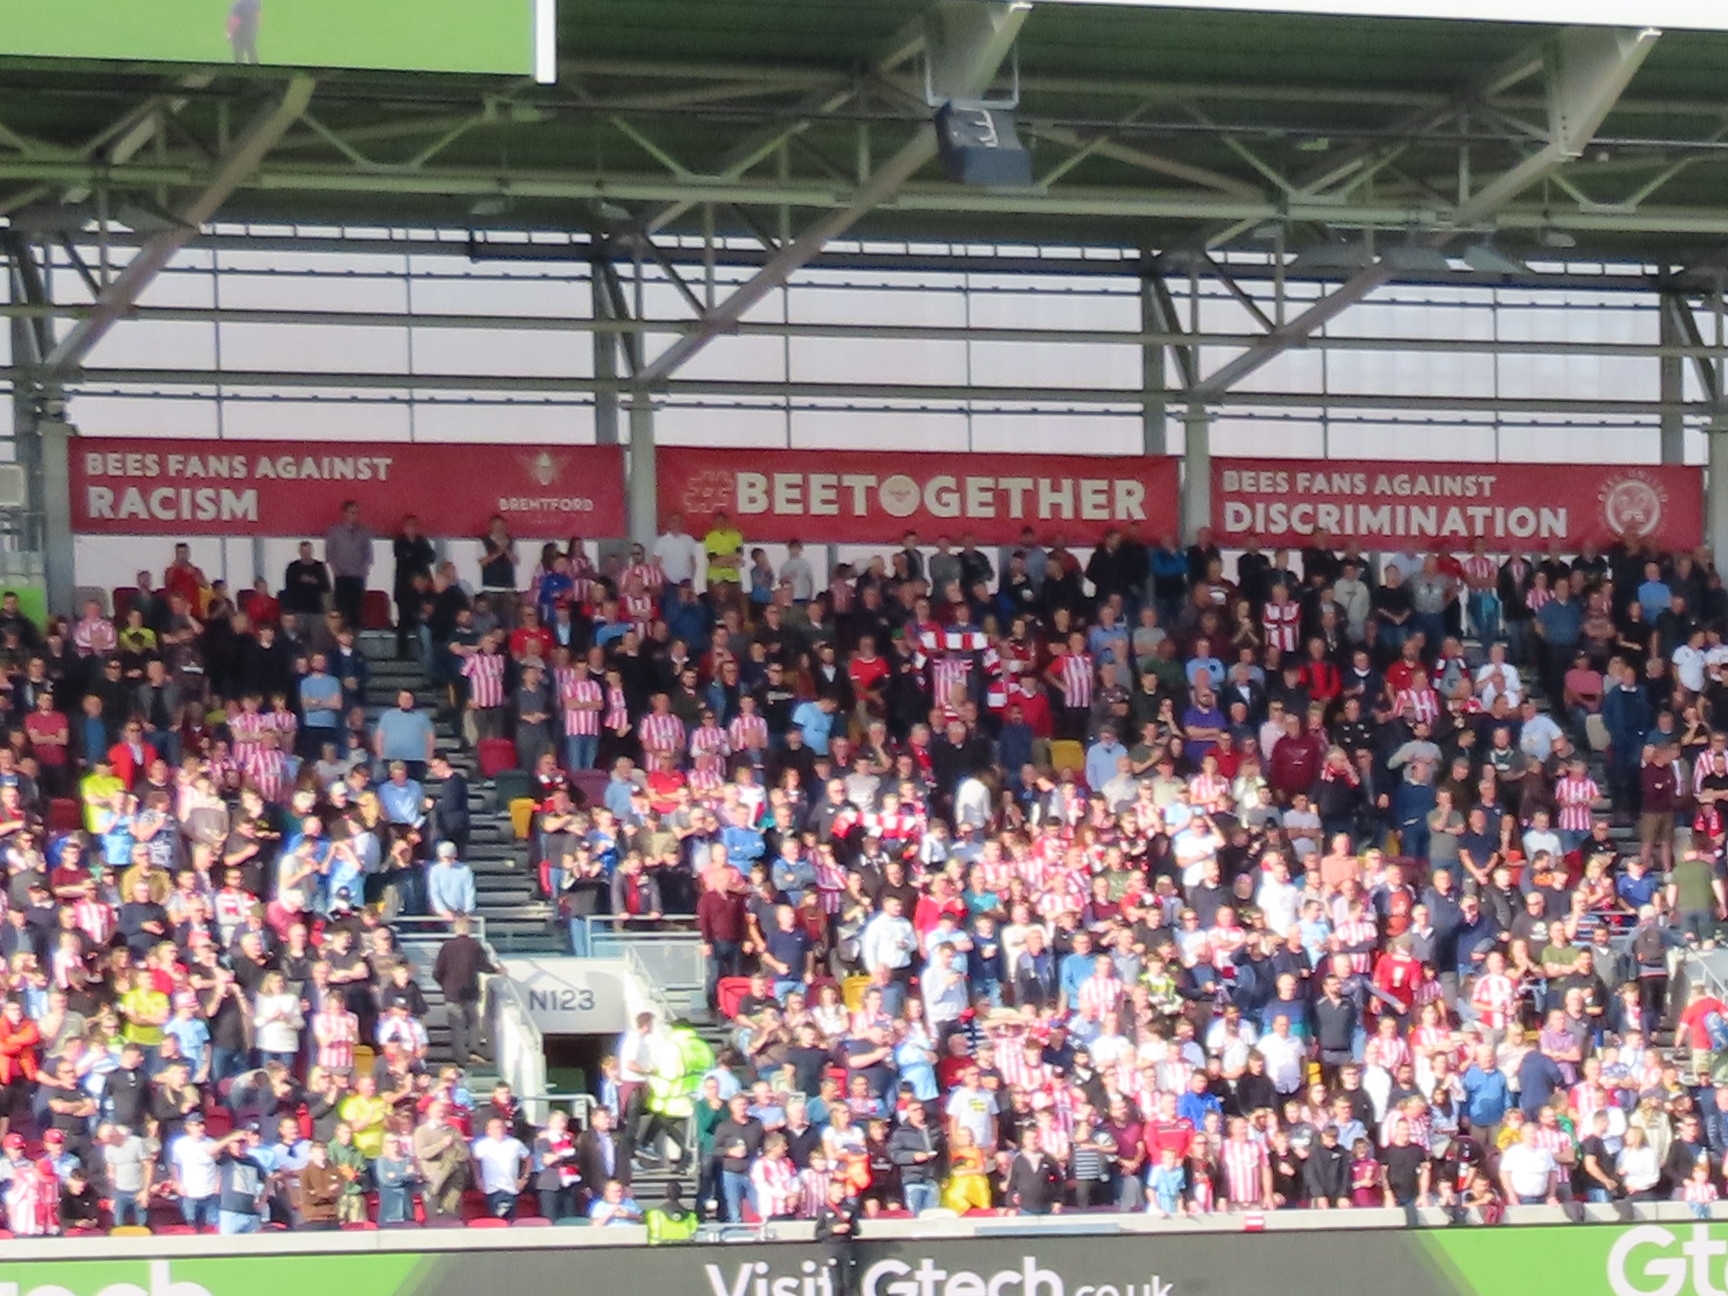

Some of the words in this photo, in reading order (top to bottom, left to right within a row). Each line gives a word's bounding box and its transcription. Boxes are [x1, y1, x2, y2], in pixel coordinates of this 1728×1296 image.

[85, 453, 160, 478] BEES
[167, 454, 248, 480] FANS
[255, 456, 393, 481] AGAINST
[1223, 470, 1290, 495] BEES
[1296, 472, 1367, 496] FANS
[1373, 474, 1497, 498] AGAINST
[87, 485, 259, 523] RACISM
[1224, 502, 1568, 538] DISCRIMINATION
[529, 989, 596, 1012] N123
